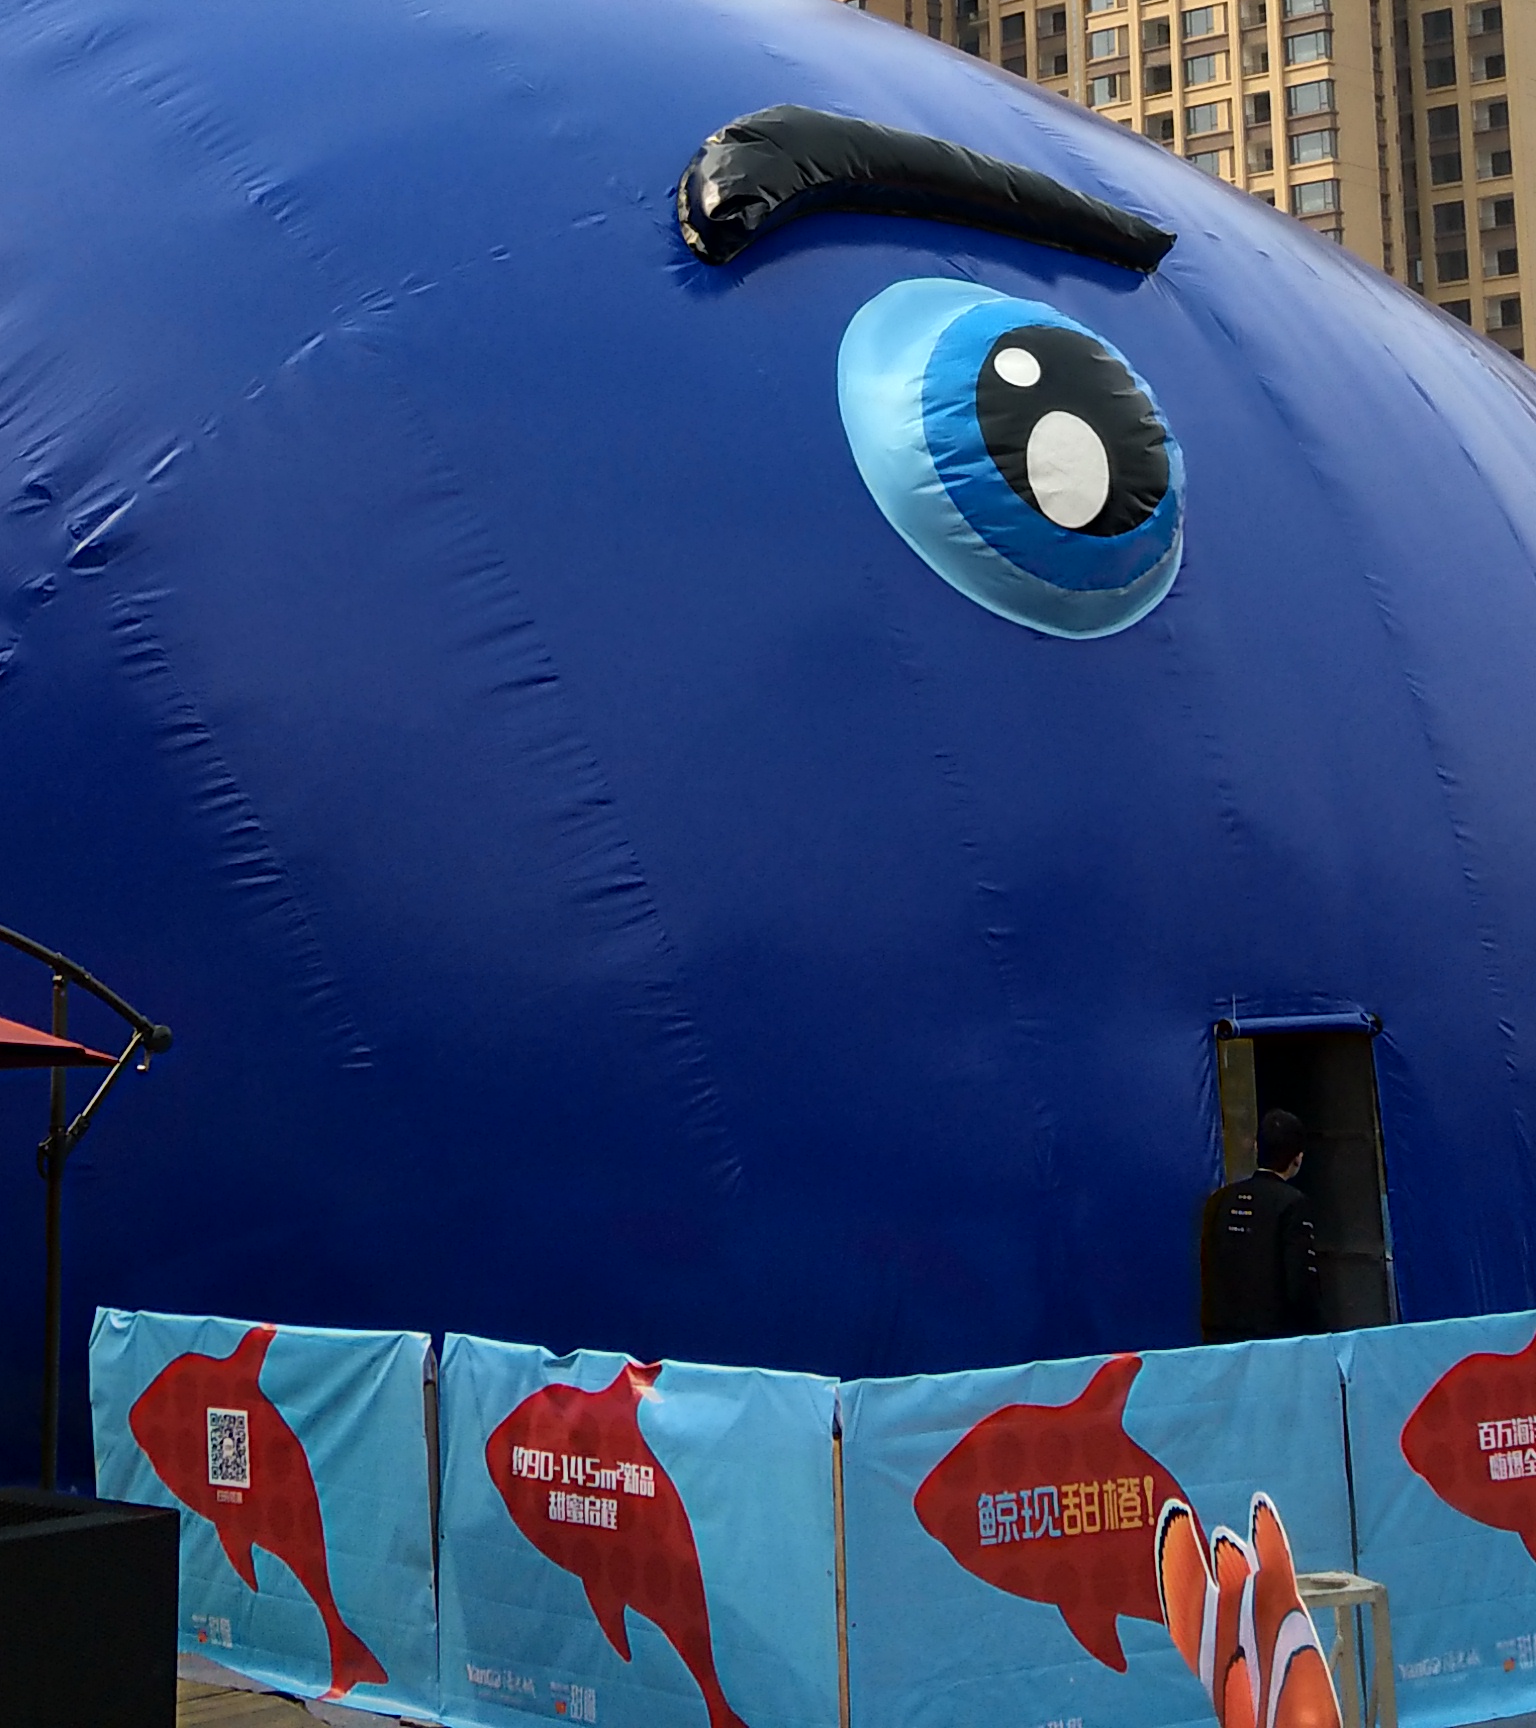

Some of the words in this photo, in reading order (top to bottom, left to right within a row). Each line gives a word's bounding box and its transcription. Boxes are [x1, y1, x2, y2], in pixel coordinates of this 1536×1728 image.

[548, 1490, 618, 1530] 甜蜜启程
[977, 1475, 1155, 1546] 鲸现甜橙!
